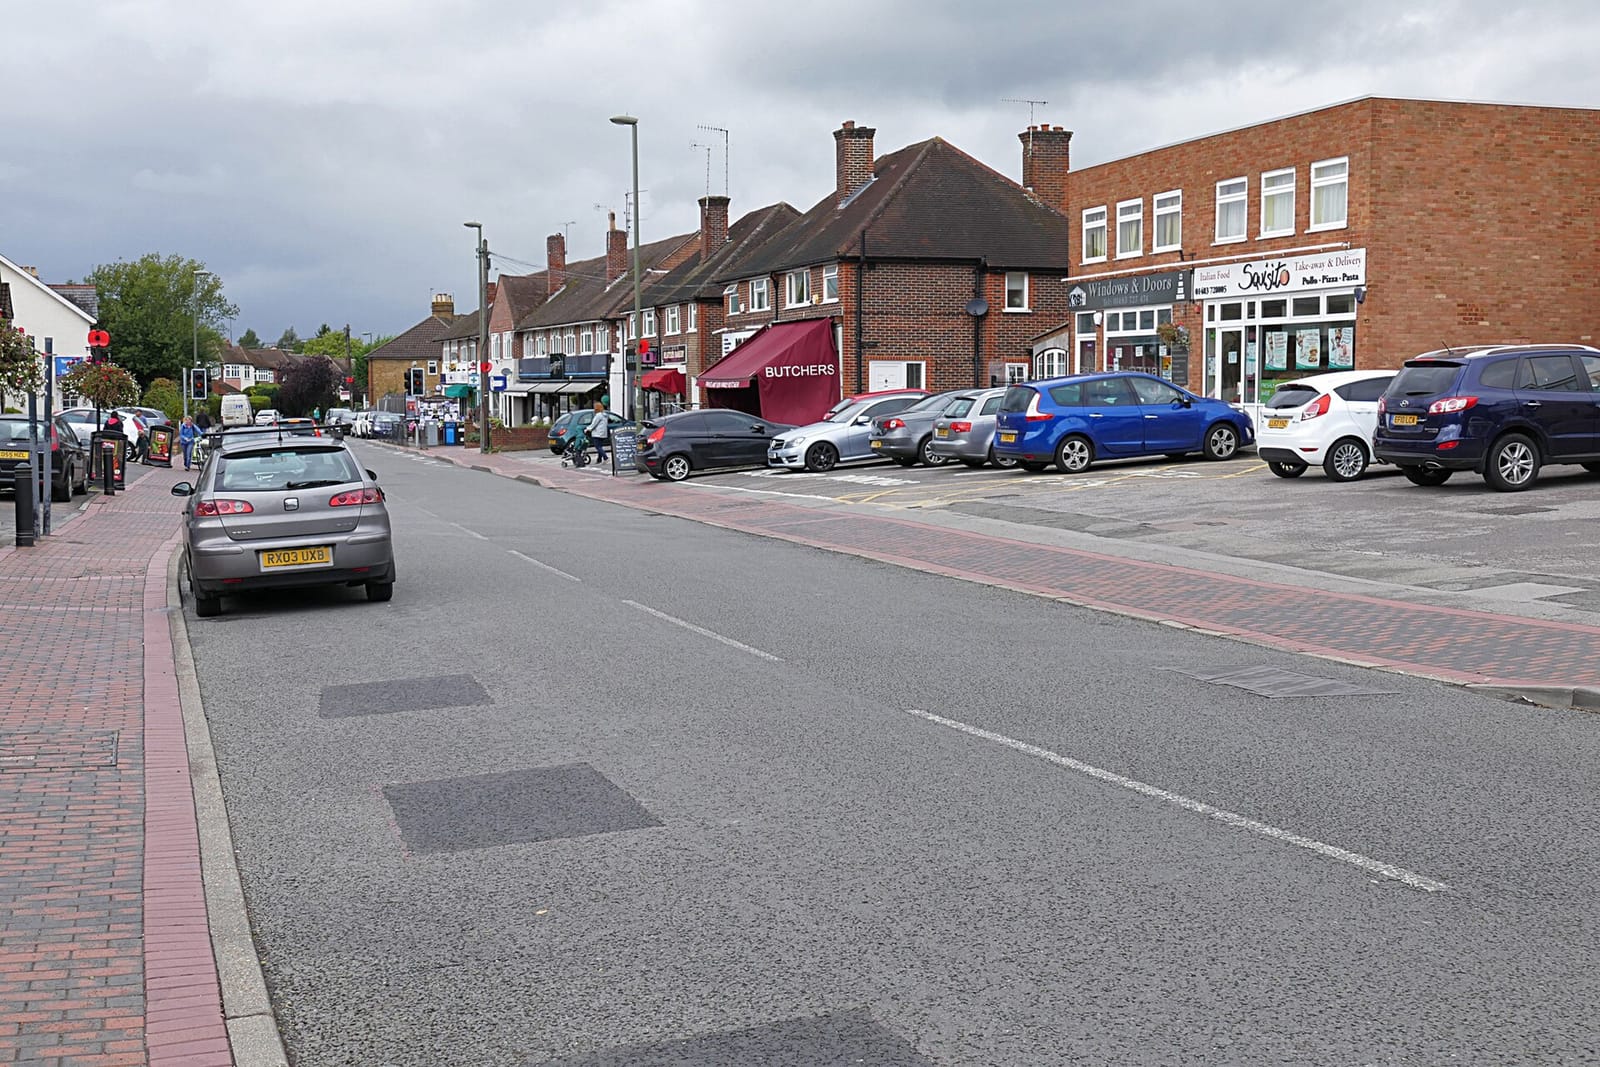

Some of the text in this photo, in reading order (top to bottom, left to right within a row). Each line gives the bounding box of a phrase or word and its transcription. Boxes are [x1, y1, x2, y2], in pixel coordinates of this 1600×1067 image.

[1294, 256, 1361, 272] Take-away & Delivery
[1217, 269, 1230, 280] Food
[1322, 275, 1338, 284] Pizza
[1342, 273, 1359, 282] Pasta
[1088, 281, 1129, 297] Windows
[1131, 279, 1139, 293] &
[1143, 277, 1172, 292] Doors
[765, 364, 835, 378] BUTCHERS
[267, 549, 324, 565] RX03 UXB
